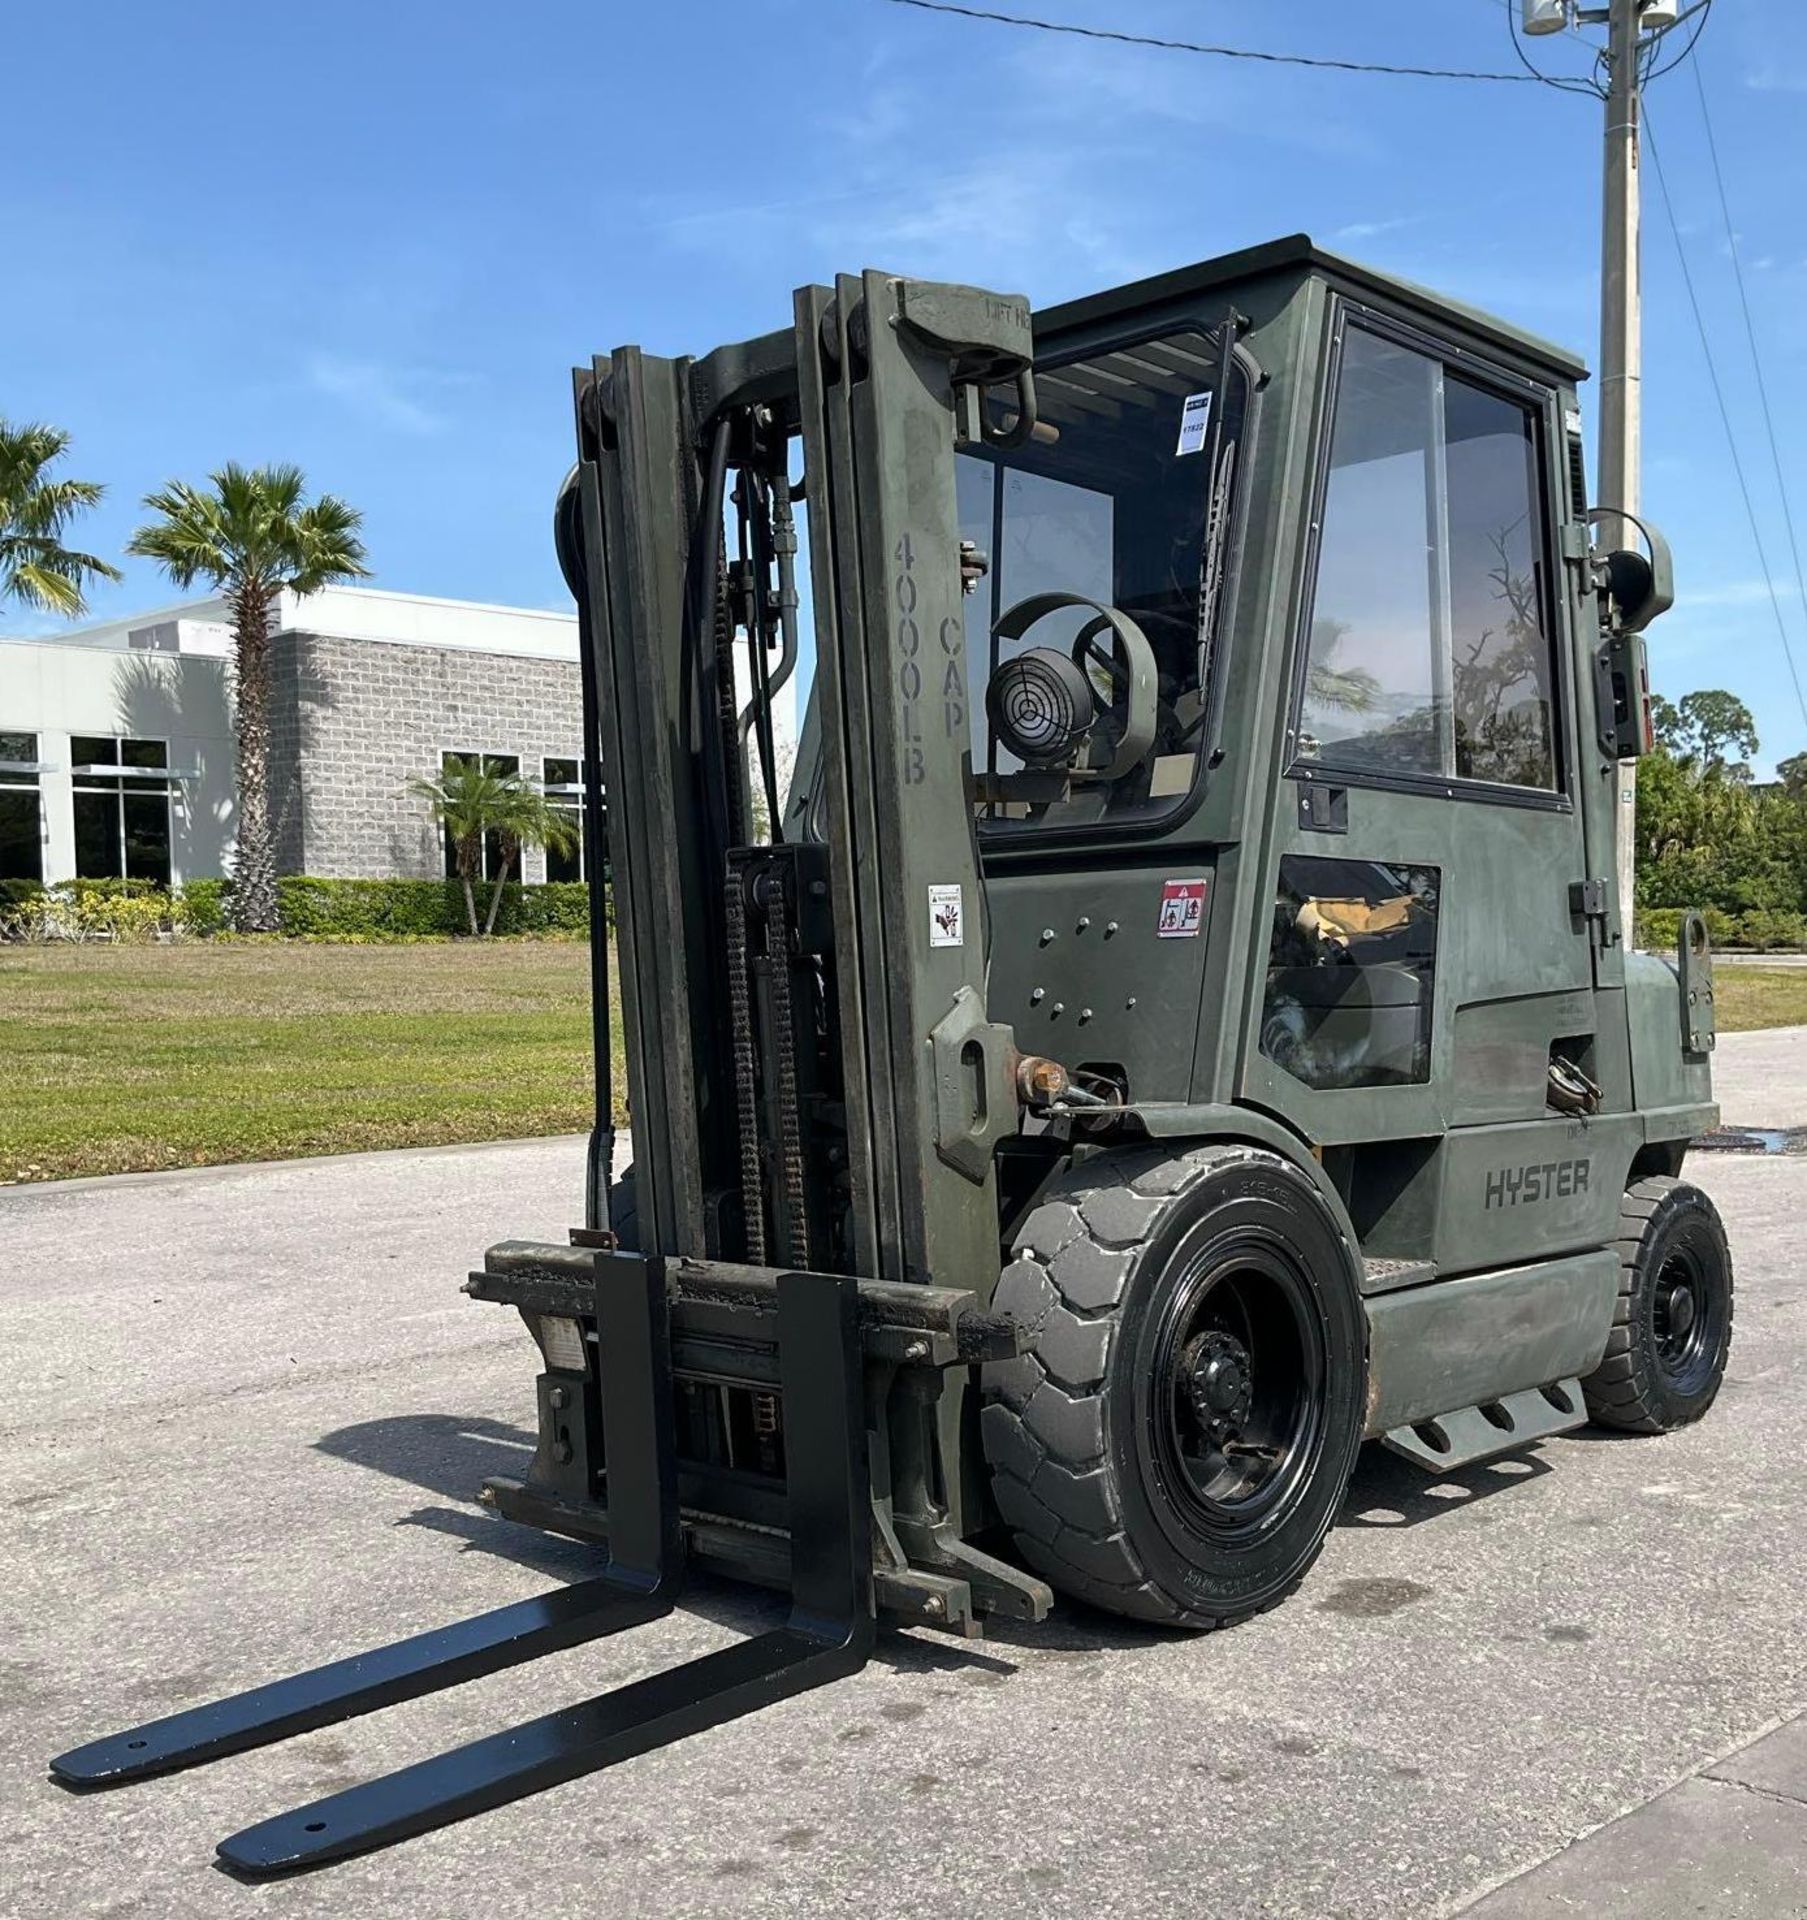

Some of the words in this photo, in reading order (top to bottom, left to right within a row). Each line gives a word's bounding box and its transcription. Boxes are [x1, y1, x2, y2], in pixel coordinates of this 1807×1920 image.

[895, 532, 925, 785] 4000LB
[939, 616, 963, 739] CAP
[1485, 1159, 1590, 1209] HYSTER
